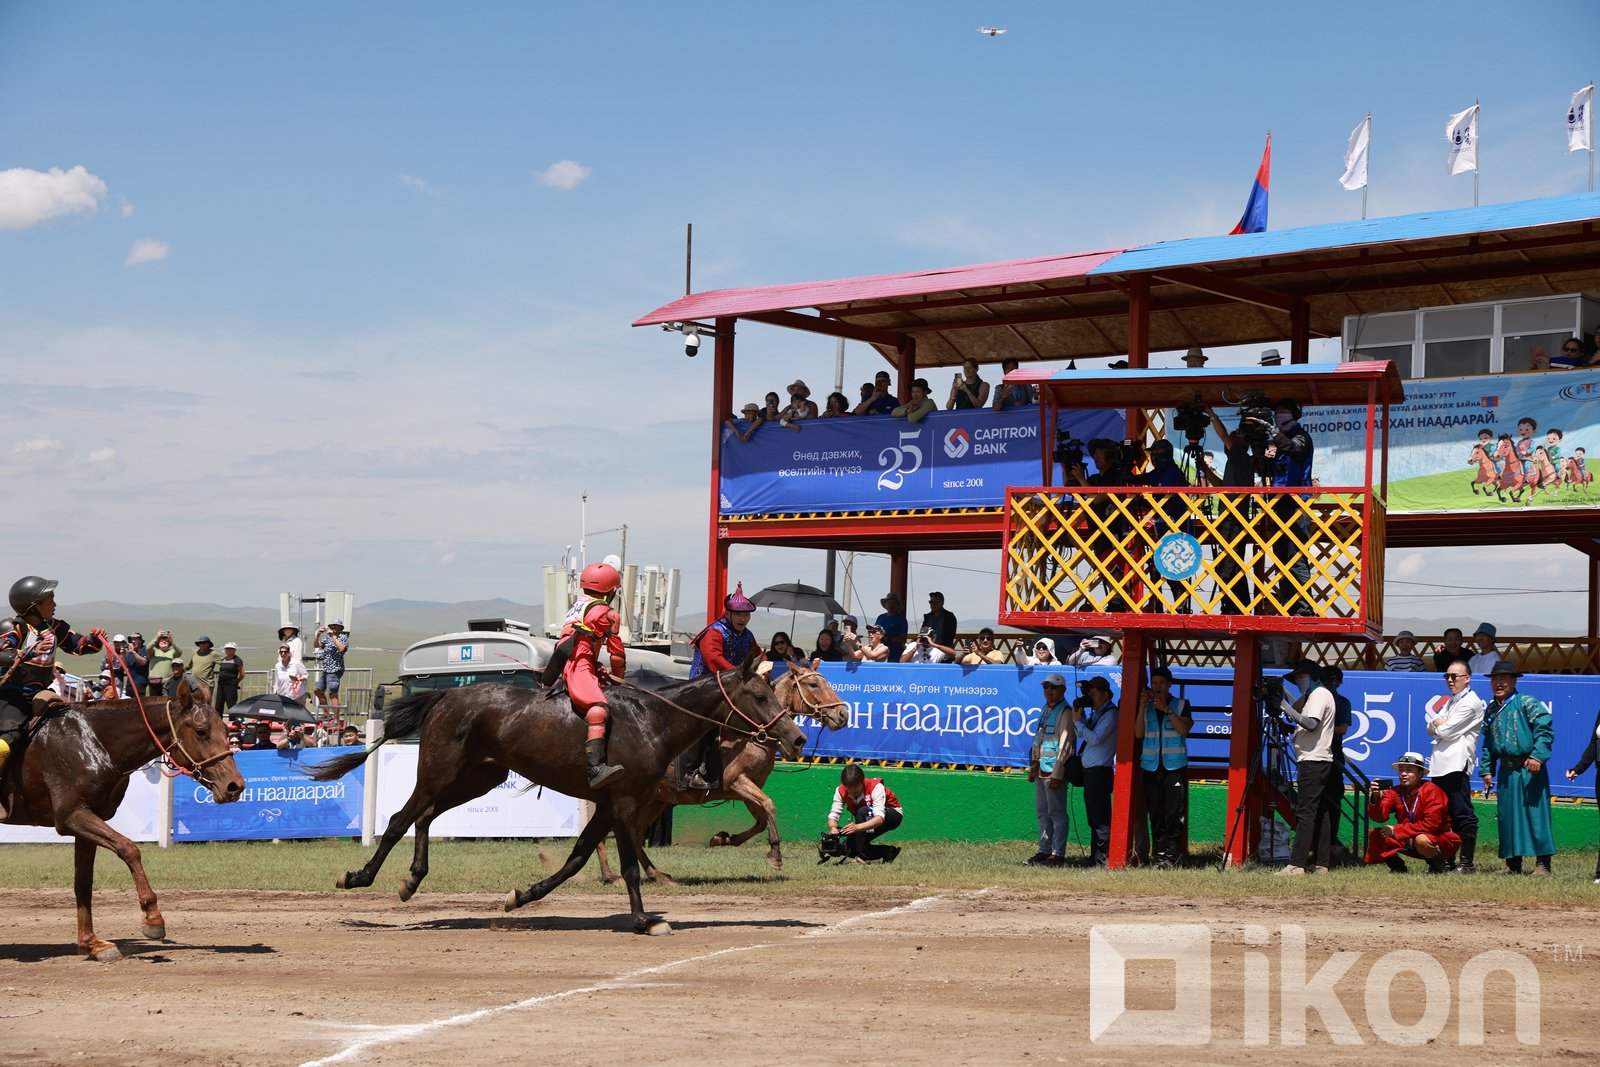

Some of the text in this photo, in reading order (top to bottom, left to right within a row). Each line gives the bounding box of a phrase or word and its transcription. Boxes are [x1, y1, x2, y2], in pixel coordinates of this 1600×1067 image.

[1456, 400, 1481, 408] БАЙНА
[1417, 410, 1498, 428] НААДААРАЙ.
[974, 426, 1037, 440] CAPITRON
[974, 442, 1007, 455] BANK
[793, 450, 863, 462] Өнөд дэвжих,
[877, 428, 923, 491] 25
[778, 465, 862, 477] өсөлтийн түүчээ
[943, 477, 984, 488] since 2001
[863, 683, 906, 694] дэвжиж,
[909, 683, 940, 695] Өргөн
[944, 685, 998, 697] түмнээрээ
[881, 702, 1042, 748] наадаара
[1342, 691, 1396, 761] 25
[496, 781, 517, 789] ANK
[257, 782, 345, 805] наадаарай
